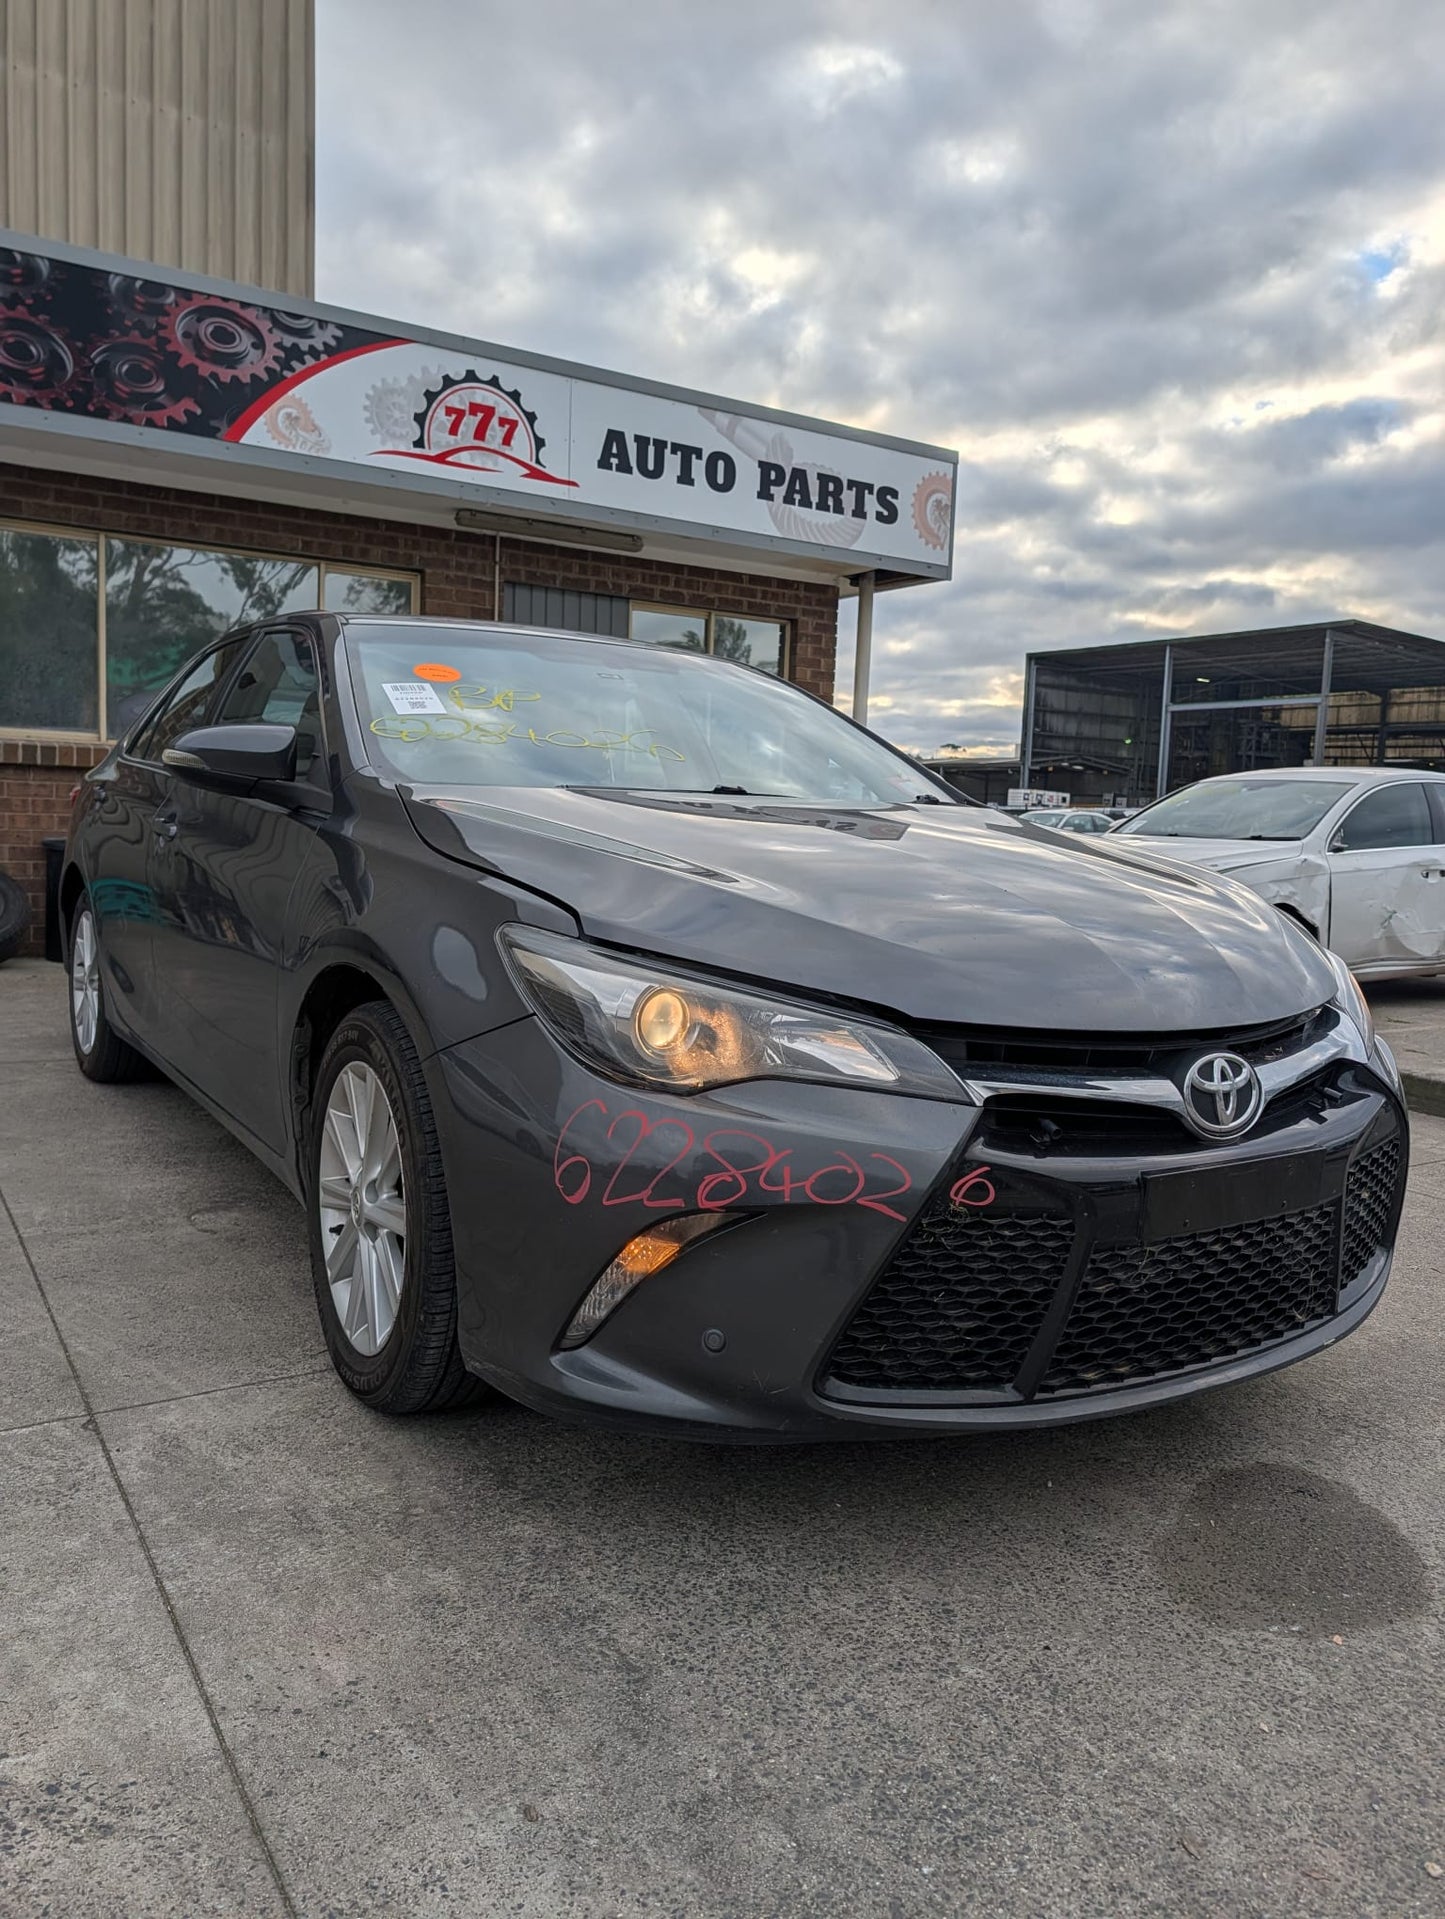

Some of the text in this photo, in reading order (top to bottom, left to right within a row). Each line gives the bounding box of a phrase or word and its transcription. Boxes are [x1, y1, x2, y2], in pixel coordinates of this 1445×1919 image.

[444, 401, 519, 448] 777
[597, 428, 899, 526] AUTO PARTS
